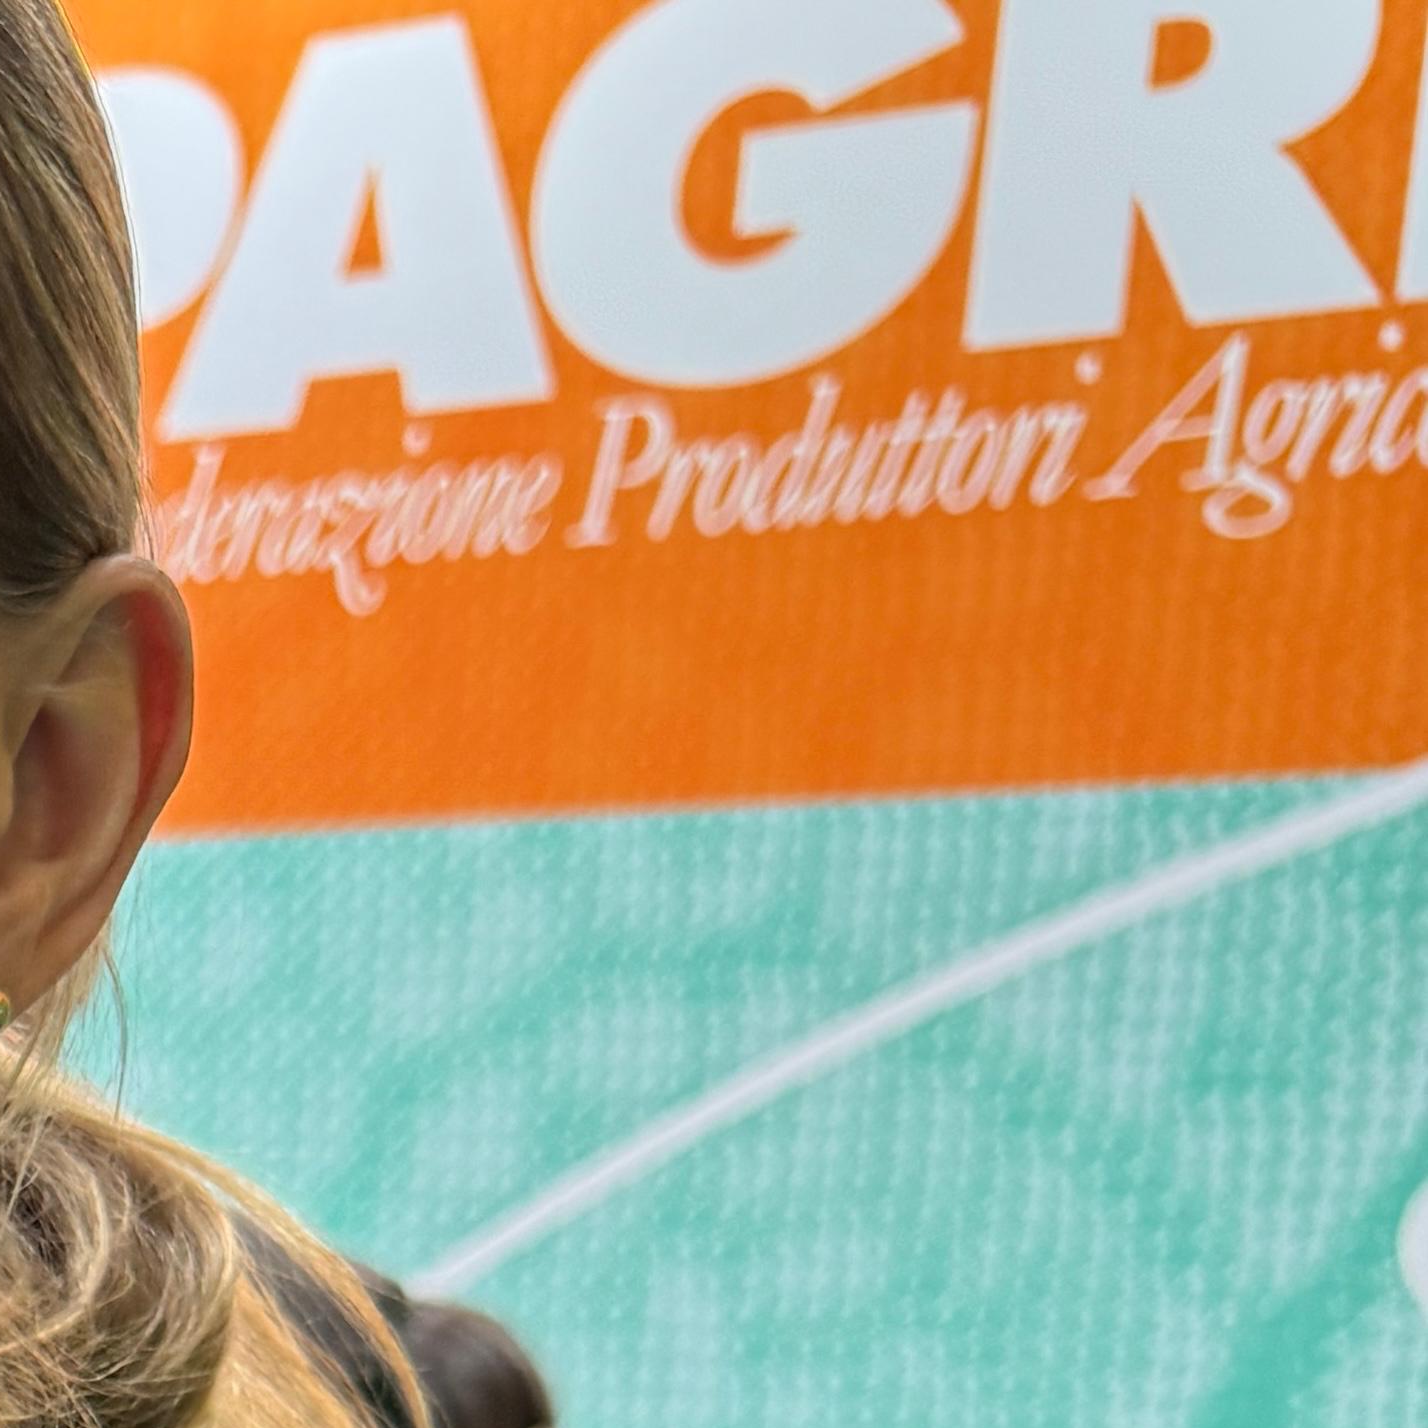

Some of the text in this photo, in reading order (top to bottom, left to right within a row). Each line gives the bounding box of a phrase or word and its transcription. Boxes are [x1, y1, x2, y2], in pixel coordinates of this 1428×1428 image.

[144, 320, 1428, 616] derazione Produttori Agric
